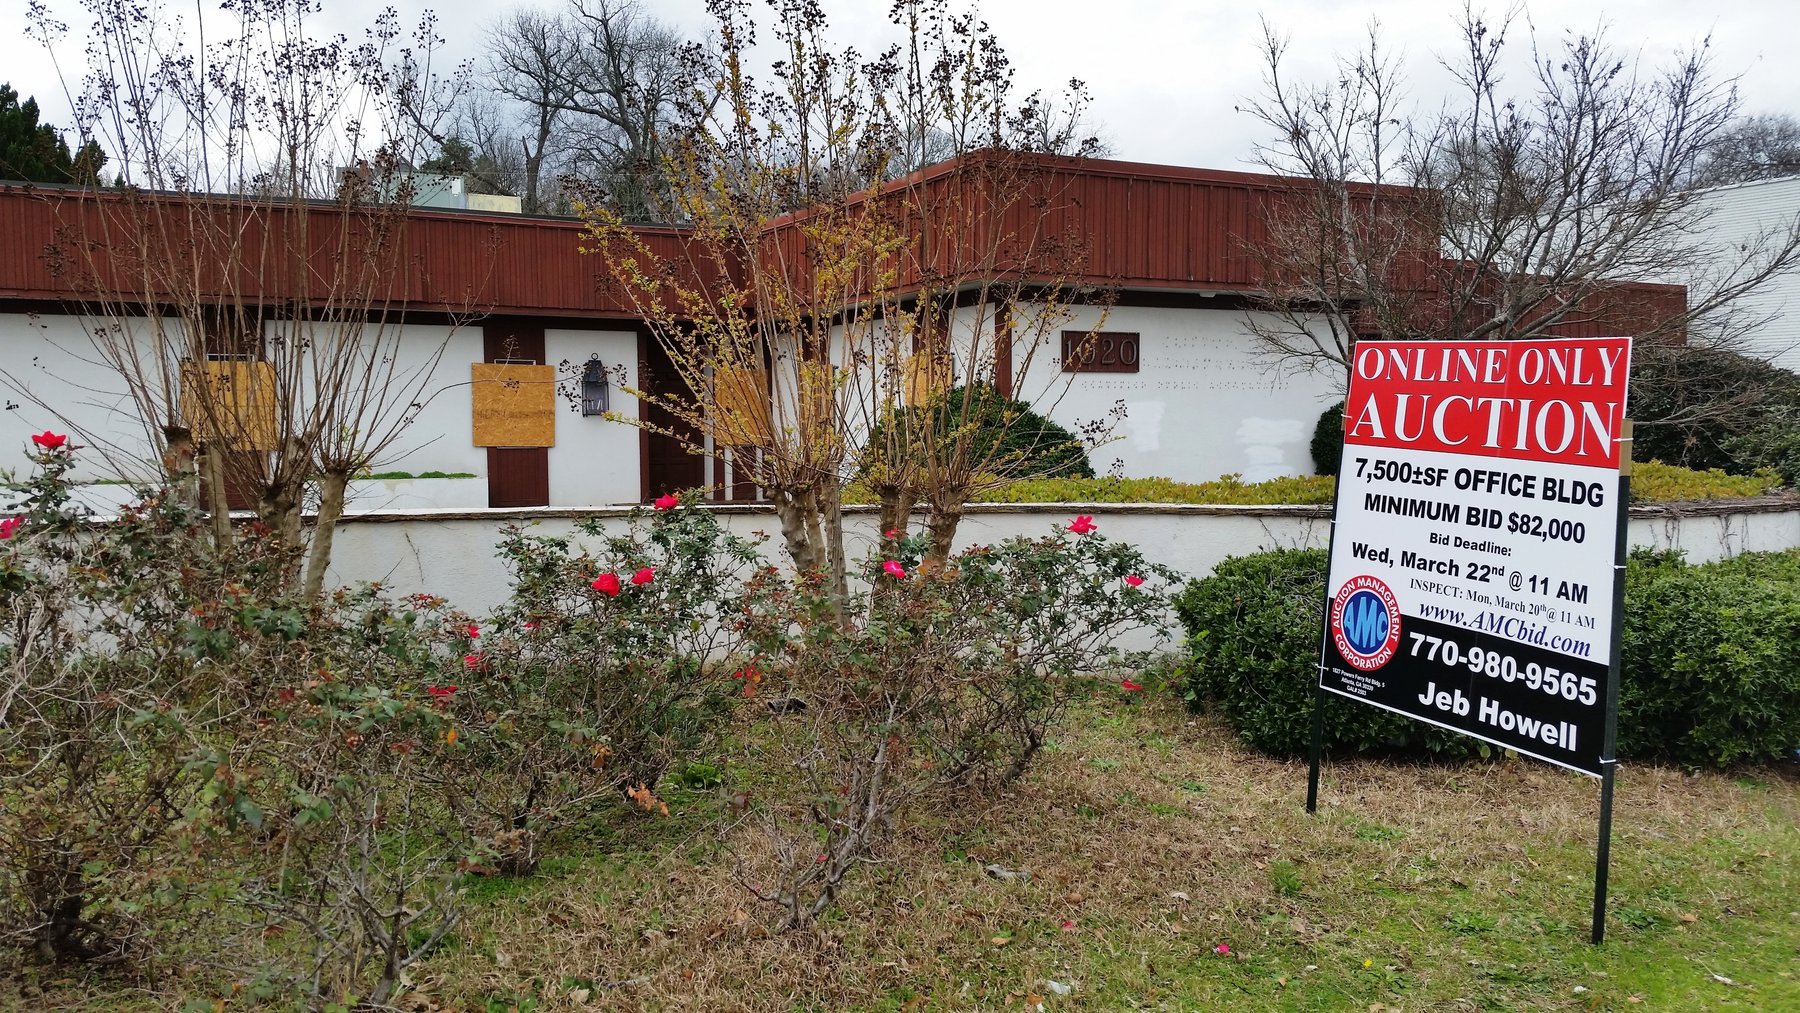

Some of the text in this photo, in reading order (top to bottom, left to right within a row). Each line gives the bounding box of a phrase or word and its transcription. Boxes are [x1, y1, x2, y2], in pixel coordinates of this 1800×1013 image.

[1358, 347, 1624, 387] ONLINE ONLY
[1350, 392, 1618, 459] AUCTION
[1355, 457, 1604, 508] 7,500±SF OFFICE BLDG
[1364, 493, 1586, 543] MINIMUM BID $82,000
[1429, 532, 1512, 556] Bid Deadline:
[1352, 541, 1588, 605] Wed, March 22nd @ 11 AM
[1333, 577, 1400, 642] AUCTION MANAGEMENT
[1344, 596, 1388, 648] AMC
[1410, 578, 1463, 599] INSPECT:
[1466, 589, 1492, 607] Mon,
[1495, 595, 1526, 613] March
[1561, 610, 1571, 624] 11
[1574, 614, 1595, 629] AM
[1335, 633, 1392, 669] CORPORATION
[1419, 603, 1591, 657] www.AMCbid.com
[1408, 631, 1597, 706] 770-980-9565
[1418, 681, 1578, 751] Jeb Howell
